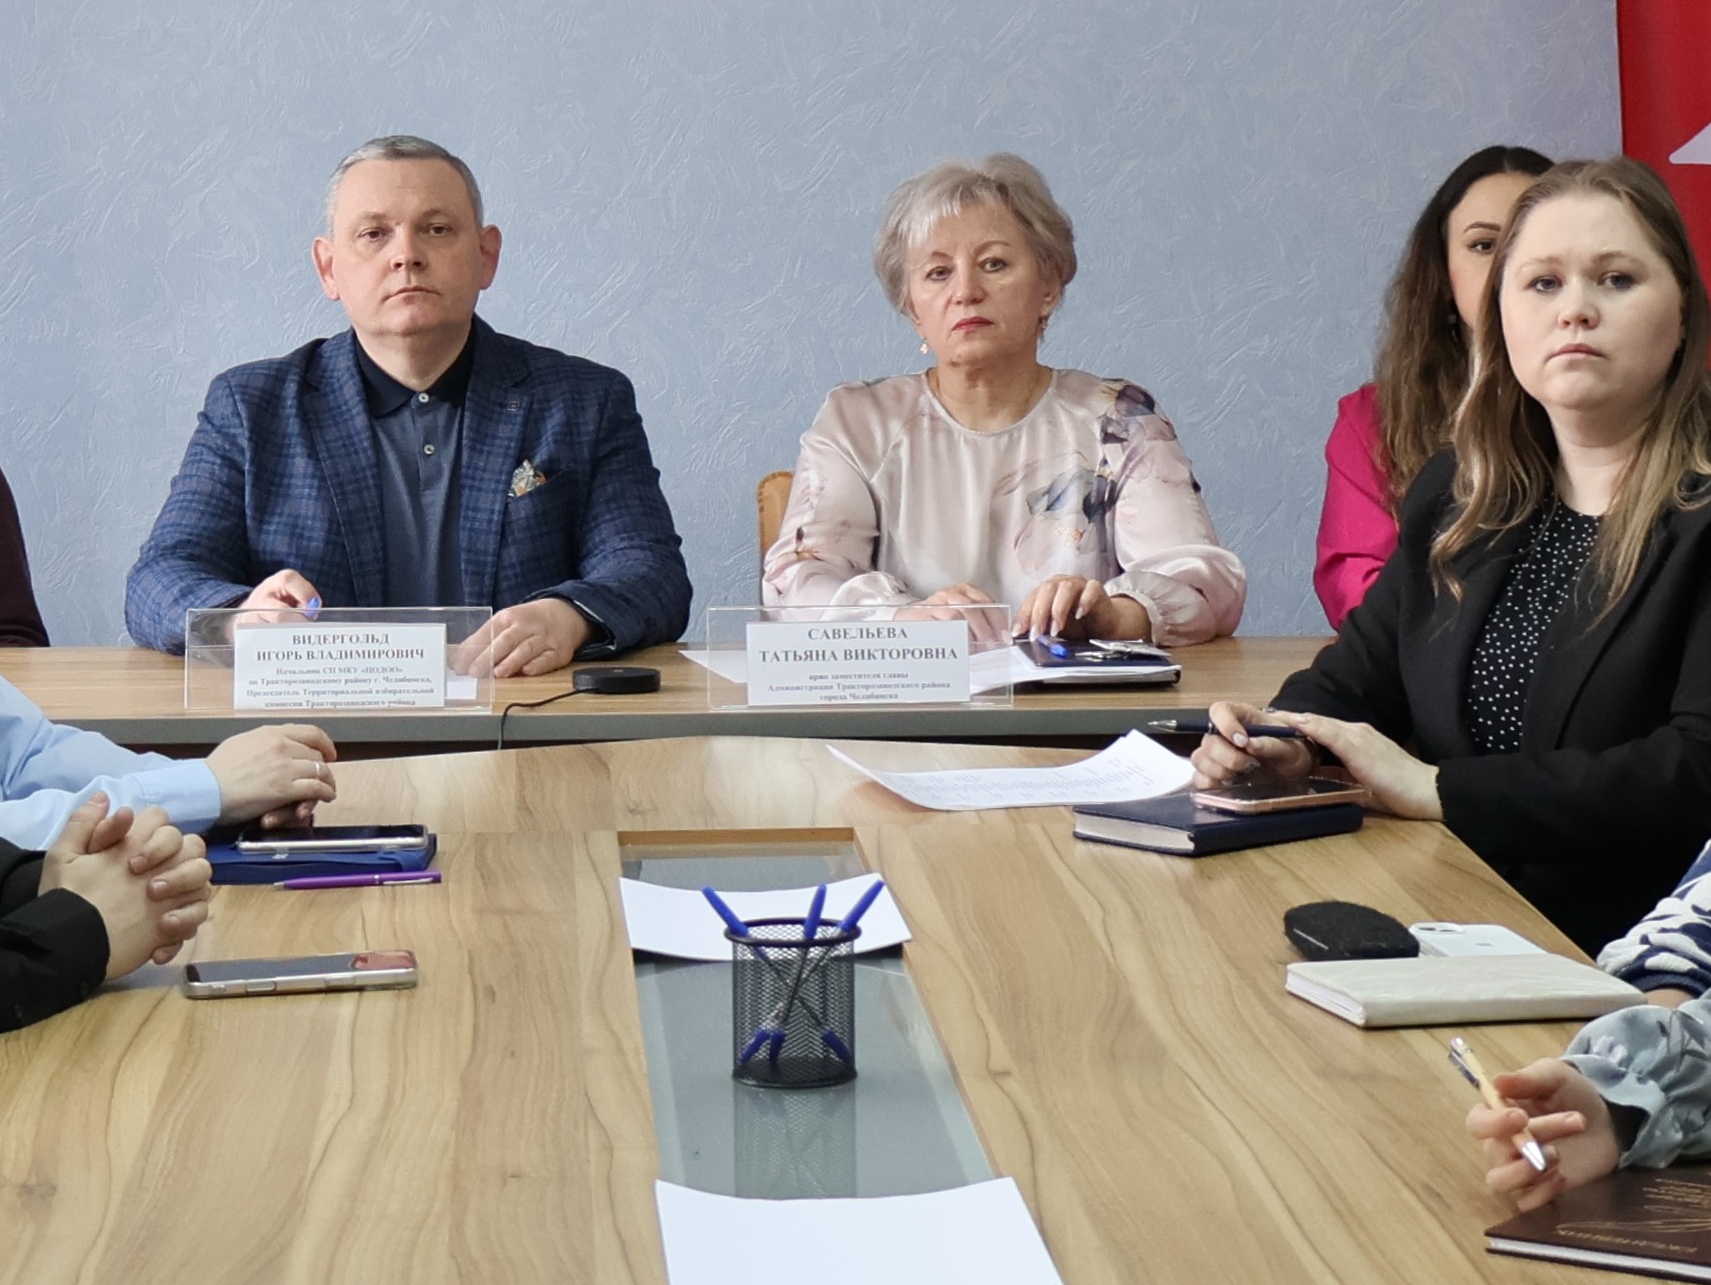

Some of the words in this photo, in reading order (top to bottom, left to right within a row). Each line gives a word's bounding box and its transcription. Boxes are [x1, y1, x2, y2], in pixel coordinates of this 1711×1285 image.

[292, 633, 390, 647] ВИДЕРГОЛЬД
[807, 627, 909, 640] САВЕЛЬЕВА
[256, 650, 302, 662] ИГОРЬ
[306, 648, 425, 661] ВЛАДИМИРОВИЧ
[758, 649, 838, 662] ТАТЬЯНА
[843, 647, 958, 661] ВИКТОРОВНА
